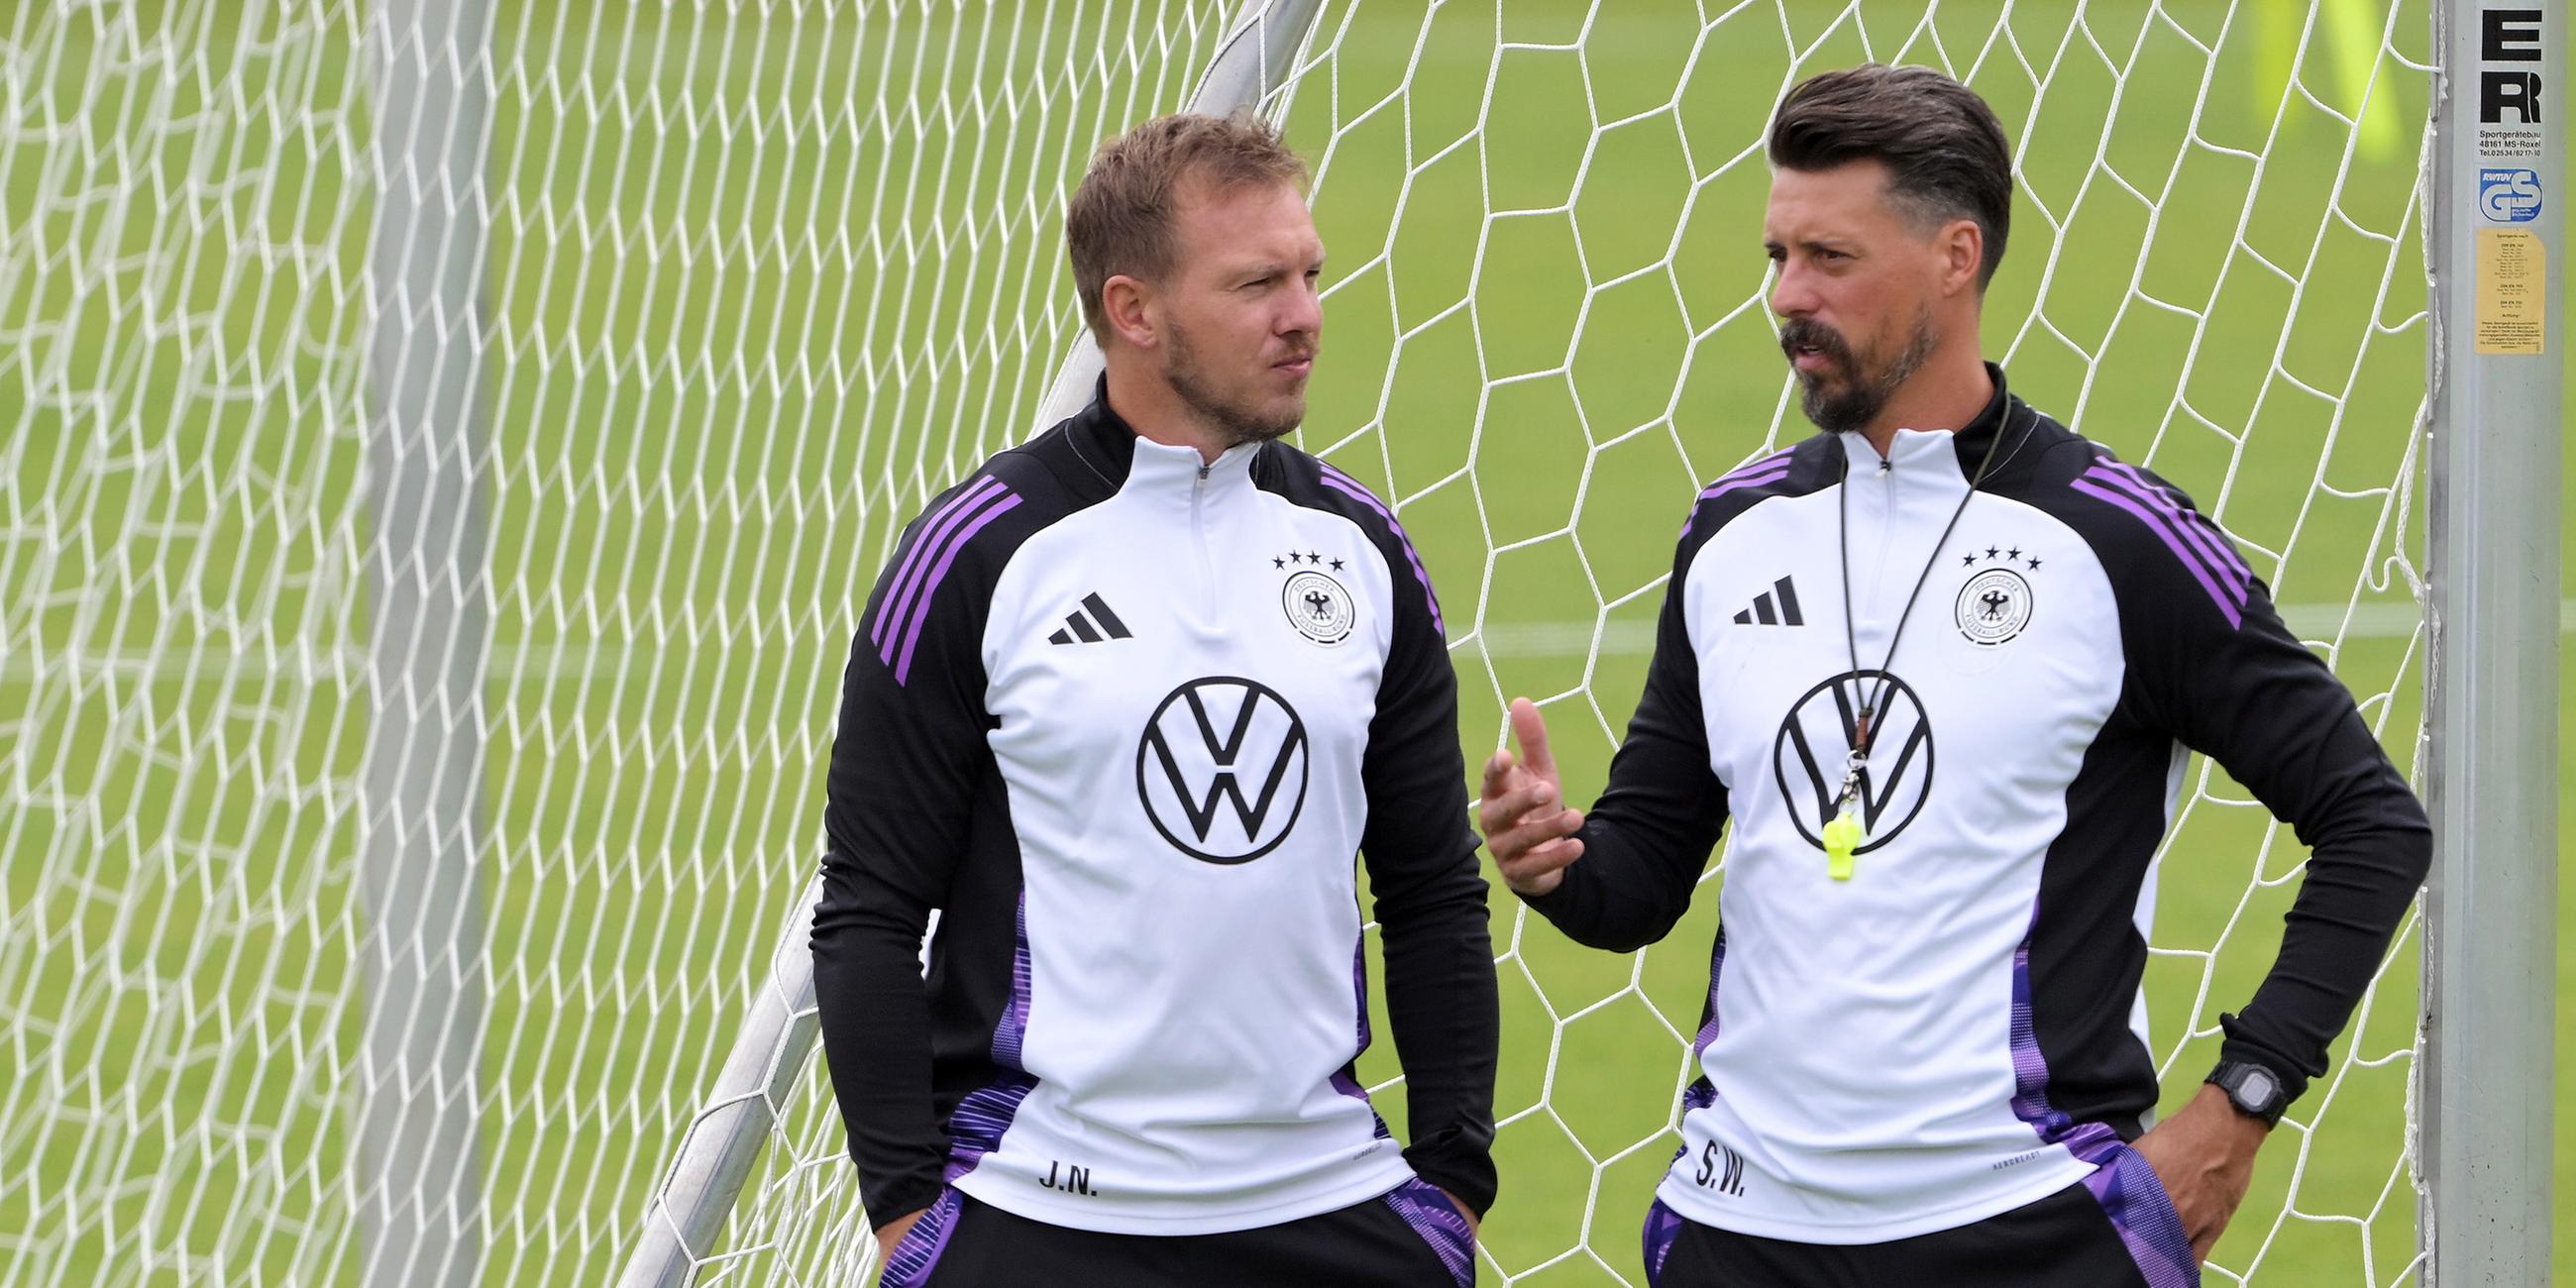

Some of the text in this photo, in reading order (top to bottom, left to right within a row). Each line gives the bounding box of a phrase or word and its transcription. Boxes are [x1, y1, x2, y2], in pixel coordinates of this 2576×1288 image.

[2480, 140, 2502, 149] 48161
[1139, 679, 1304, 850] VW
[1778, 674, 1932, 842] VW
[1038, 1159, 1098, 1196] J.N.
[1696, 1139, 1744, 1197] S.W.
